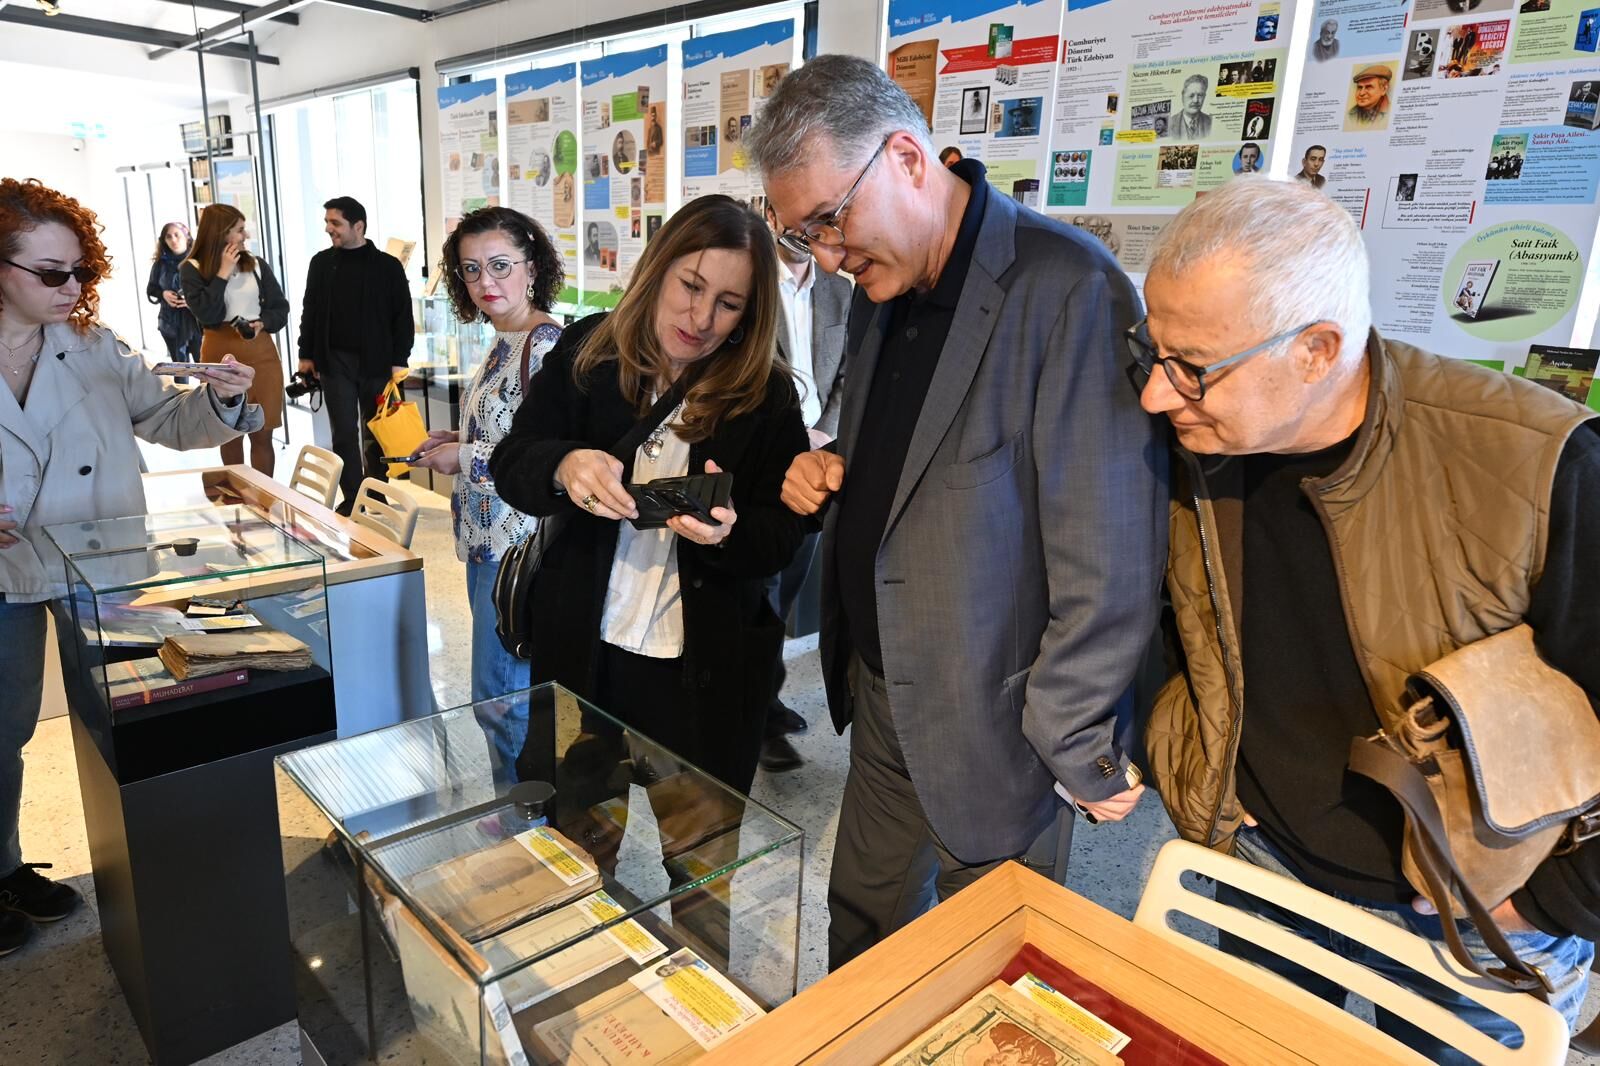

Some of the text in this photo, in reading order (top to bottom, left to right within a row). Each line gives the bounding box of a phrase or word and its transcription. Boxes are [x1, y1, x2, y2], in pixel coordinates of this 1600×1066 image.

[1149, 2, 1252, 20] Cumhuriyet Dönemi edebiyatındaki
[1204, 10, 1238, 20] temsilcileri
[1068, 36, 1106, 46] Cumhuriyet
[1068, 46, 1093, 55] Dönemi
[1084, 53, 1114, 62] Edebiyatı
[1150, 68, 1169, 76] Hikmet
[1510, 223, 1531, 232] sihirli
[1532, 225, 1555, 238] kalemi
[1511, 239, 1559, 248] Sait Faik
[1509, 250, 1579, 262] (Abasıyanık)
